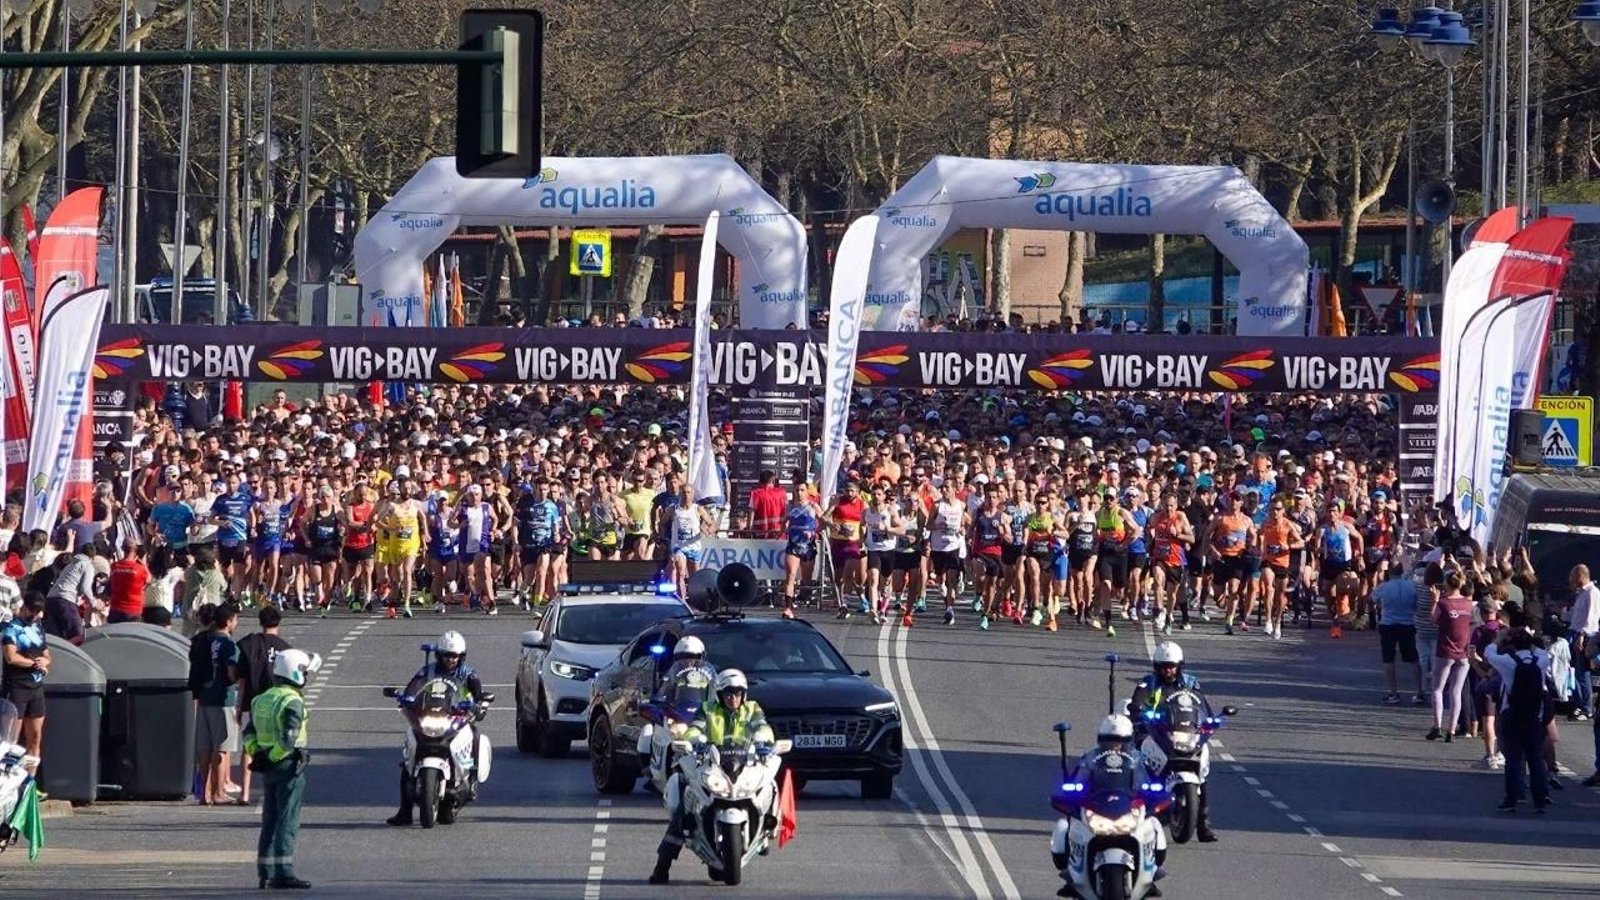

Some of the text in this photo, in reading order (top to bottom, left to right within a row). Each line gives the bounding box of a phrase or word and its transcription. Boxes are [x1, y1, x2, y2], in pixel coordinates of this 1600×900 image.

[539, 180, 655, 214] aqualia
[1035, 189, 1152, 221] aqualia
[399, 215, 443, 230] aqualia
[736, 211, 779, 227] aqualia
[891, 213, 937, 229] aqualia
[1231, 225, 1276, 240] aqualia
[376, 293, 421, 309] aqualia
[760, 289, 804, 304] aqualia
[865, 290, 911, 306] aqualia
[1250, 303, 1297, 319] aqualia
[148, 345, 255, 378] VIG BAY
[330, 346, 437, 380] VIG BAY
[515, 347, 622, 381] VIG BAY
[707, 342, 756, 385] VIG
[919, 351, 1027, 386] VIG BAY
[1100, 353, 1209, 388] VIG BAY
[1283, 356, 1391, 390] VIG BAY
[1534, 399, 1585, 410] TENCIÓN
[1487, 385, 1510, 511] aqualia
[797, 736, 843, 747] 2834 MGG
